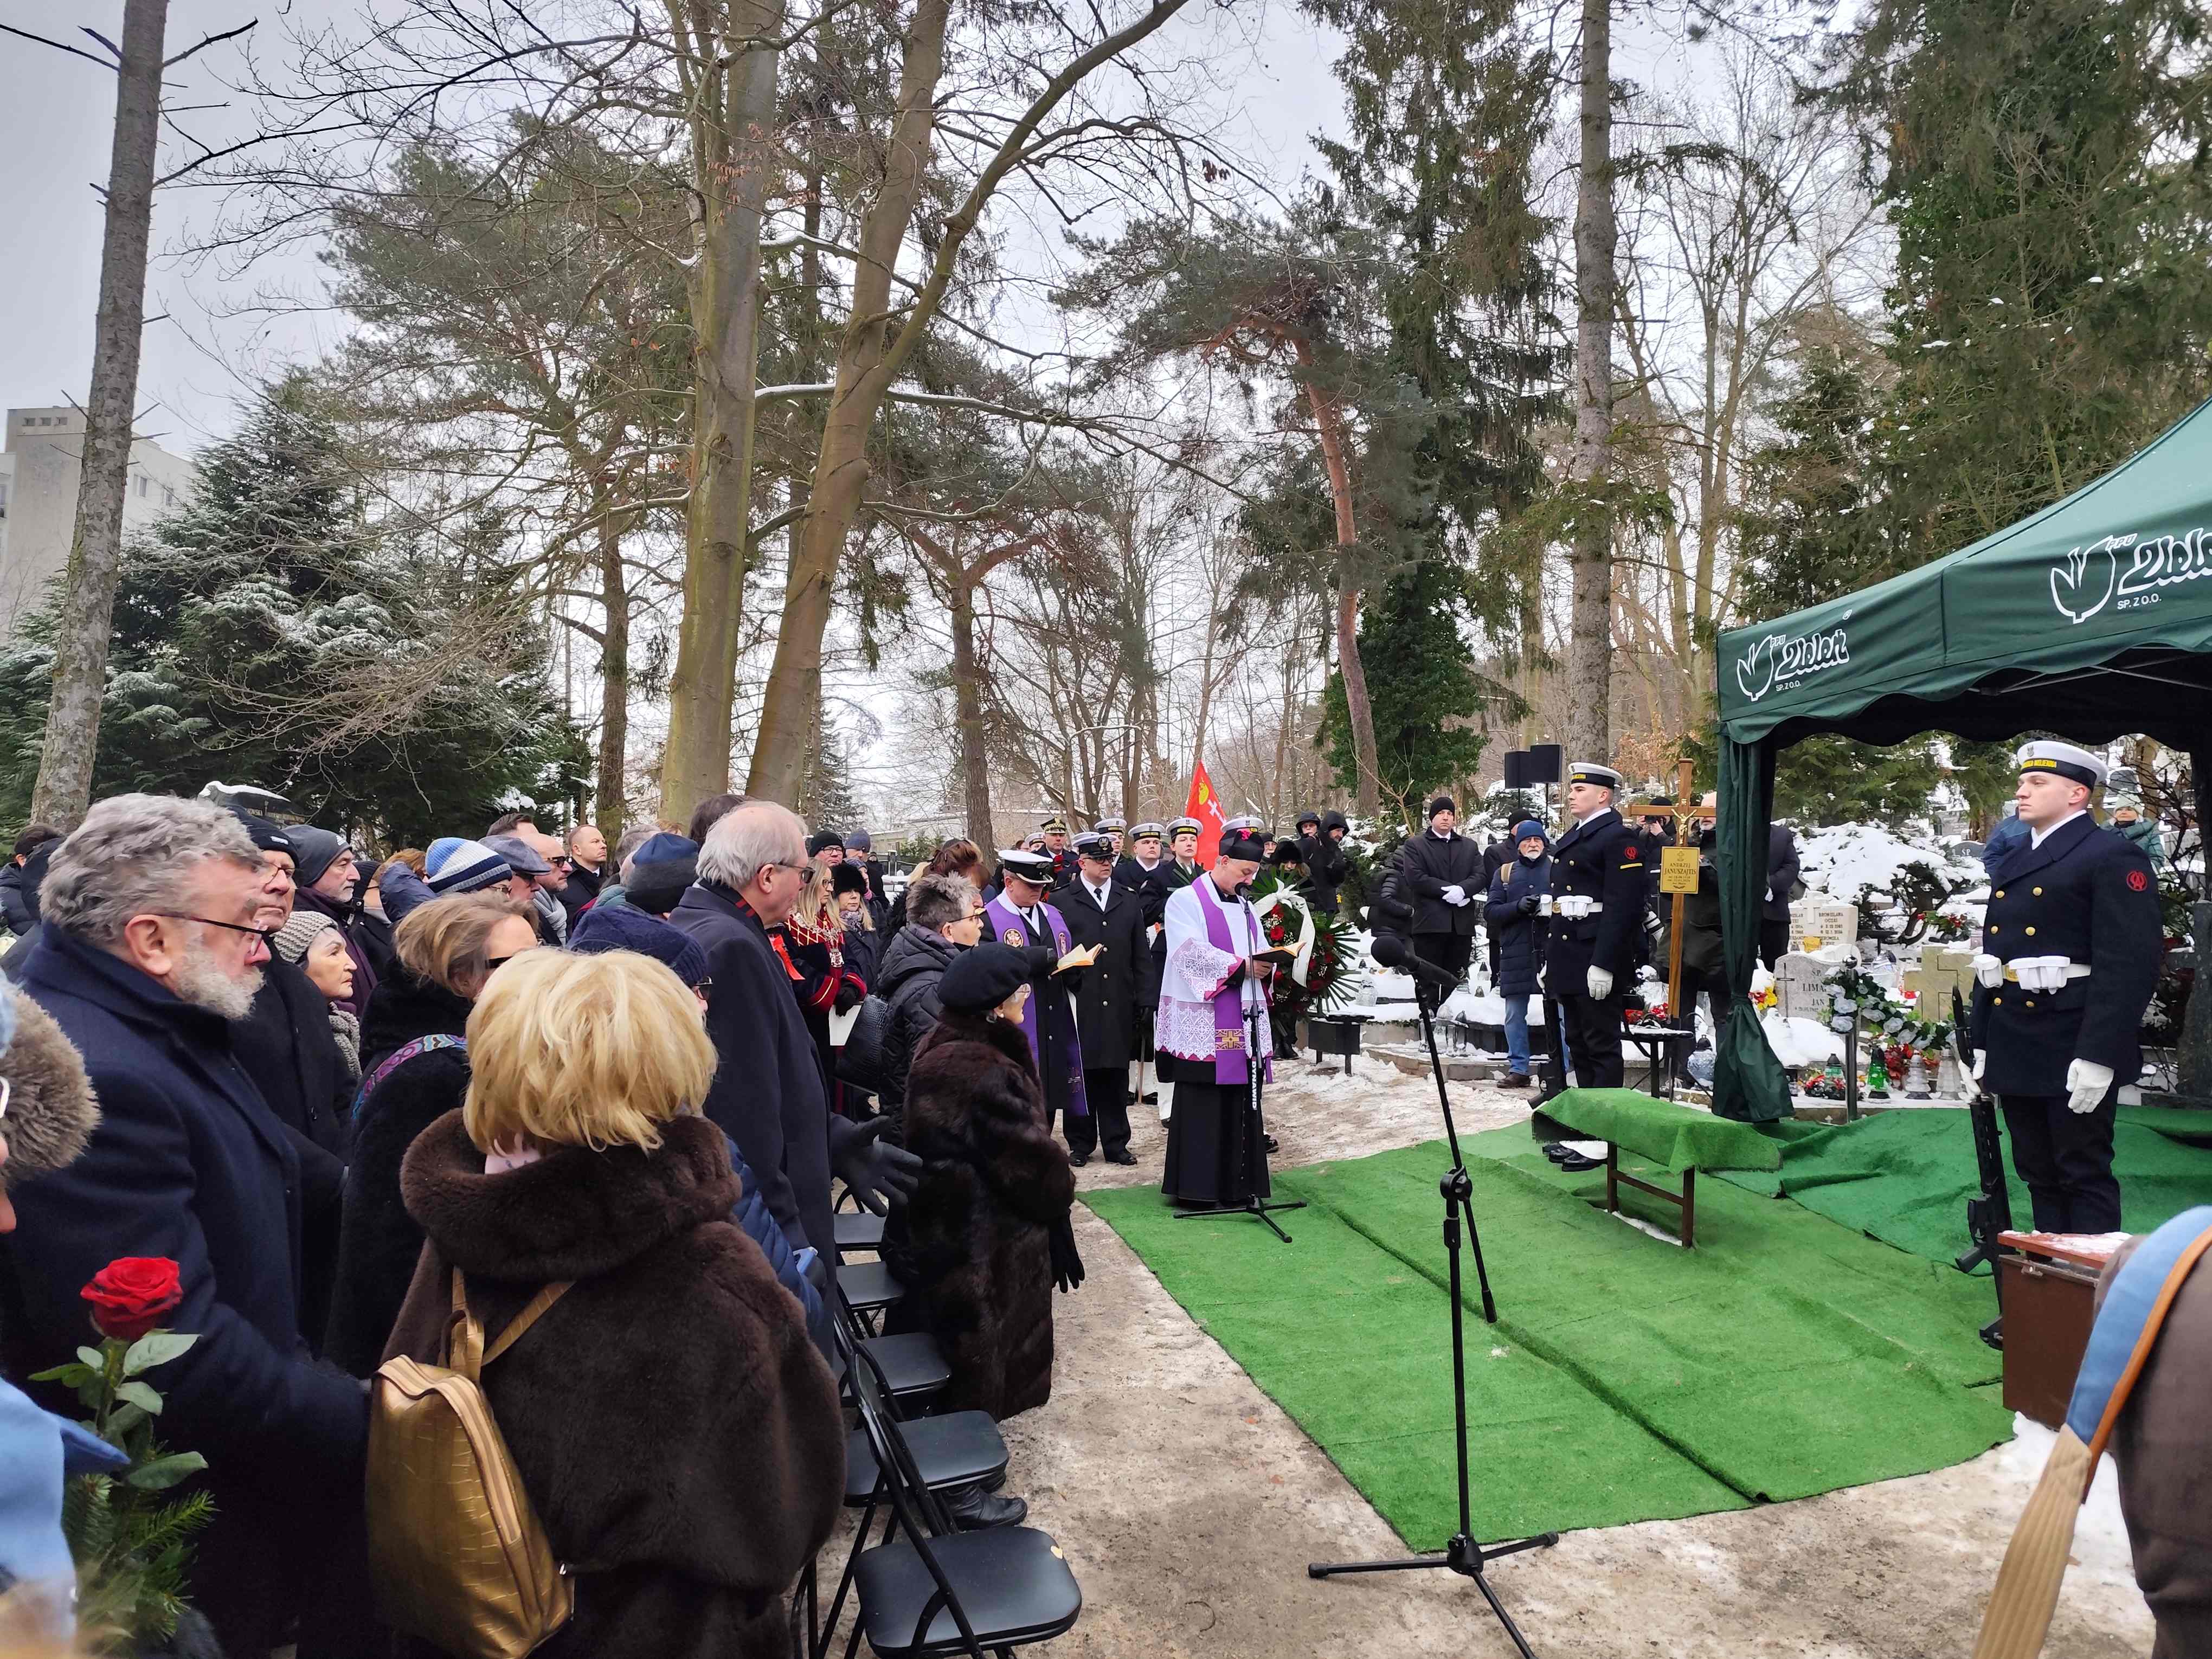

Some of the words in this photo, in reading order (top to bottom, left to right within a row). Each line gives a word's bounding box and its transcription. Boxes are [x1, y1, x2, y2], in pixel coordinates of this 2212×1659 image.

[2107, 534, 2137, 550] PPU
[2117, 600, 2131, 610] SP.
[2133, 597, 2140, 607] Z
[2141, 593, 2162, 603] O.O.
[1770, 635, 1786, 647] PPU
[1803, 983, 1827, 992] LIMA
